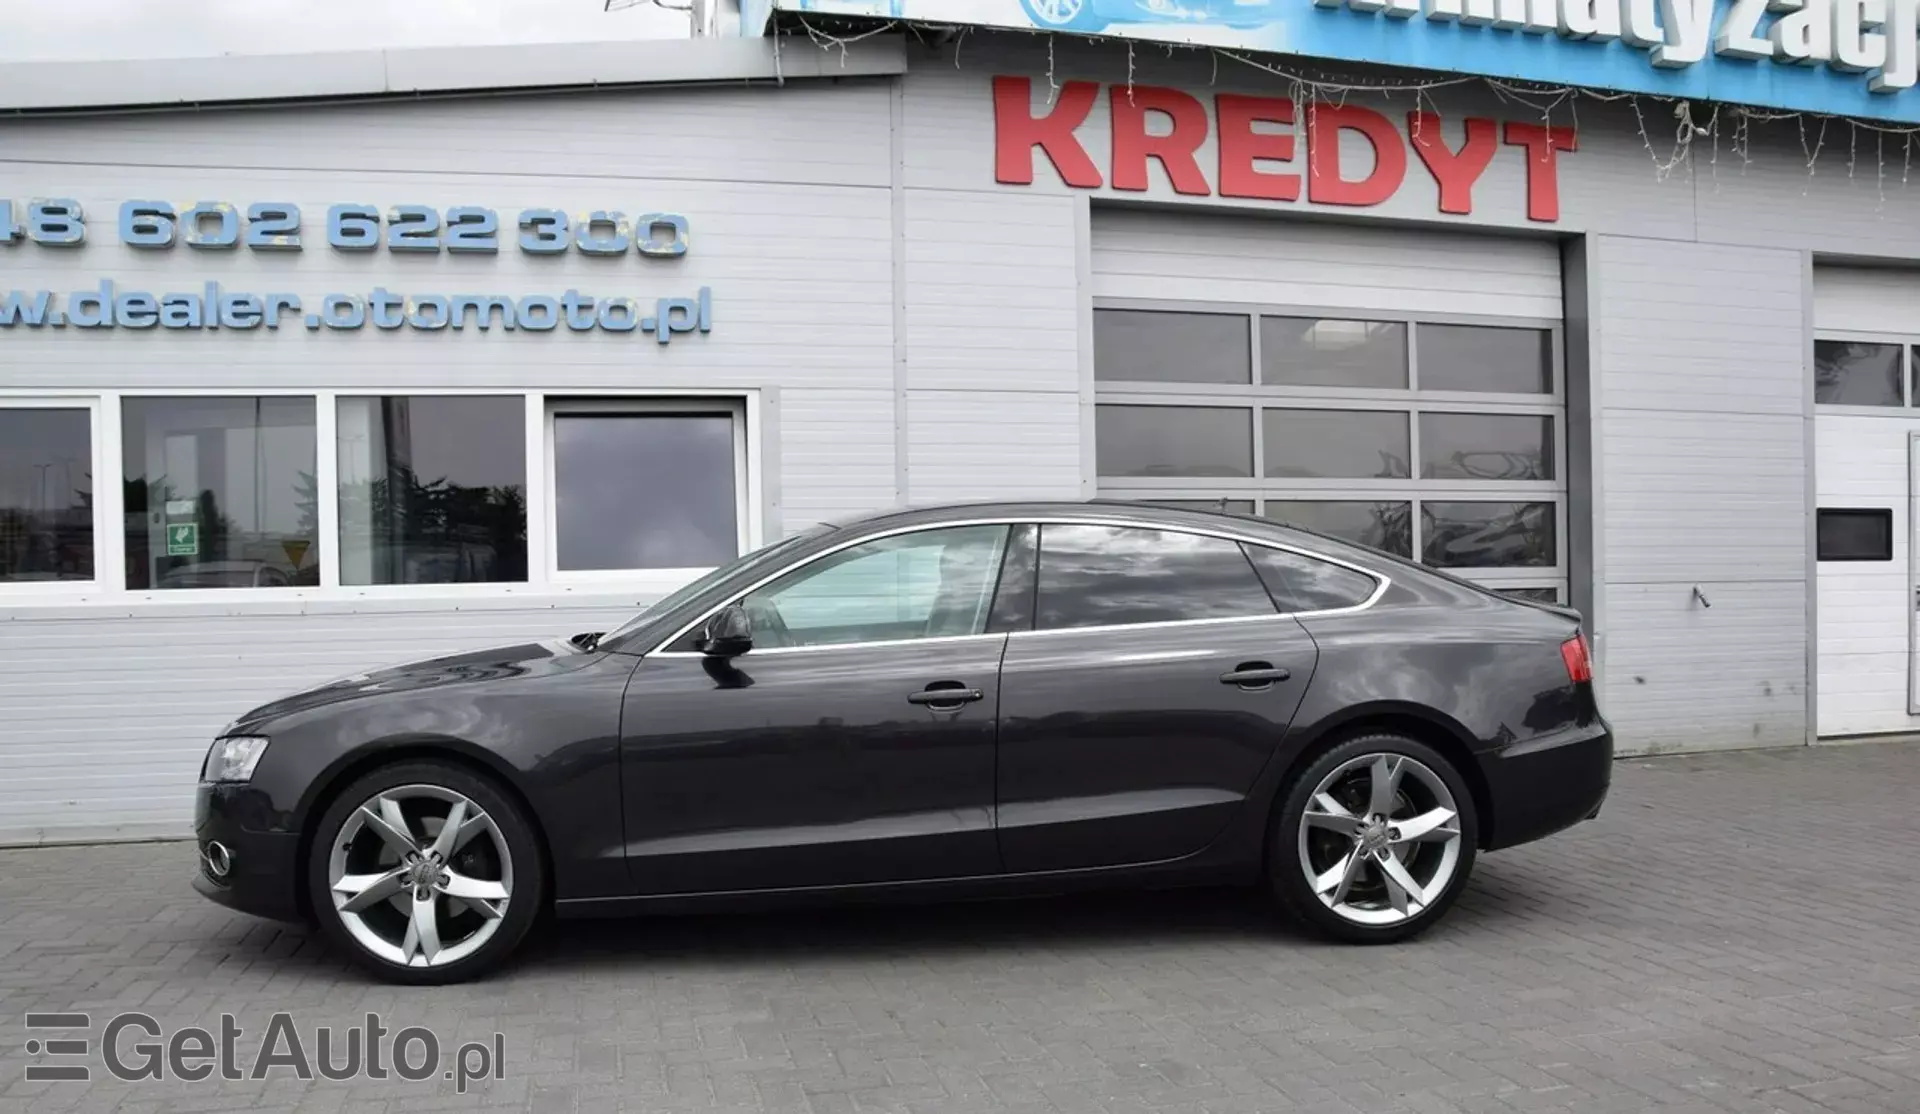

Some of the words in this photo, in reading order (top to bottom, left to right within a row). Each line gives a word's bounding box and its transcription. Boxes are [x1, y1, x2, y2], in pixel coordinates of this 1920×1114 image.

[992, 75, 1578, 221] KREDYT
[118, 199, 302, 251] 602
[327, 203, 498, 254] 622
[518, 207, 690, 257] 300
